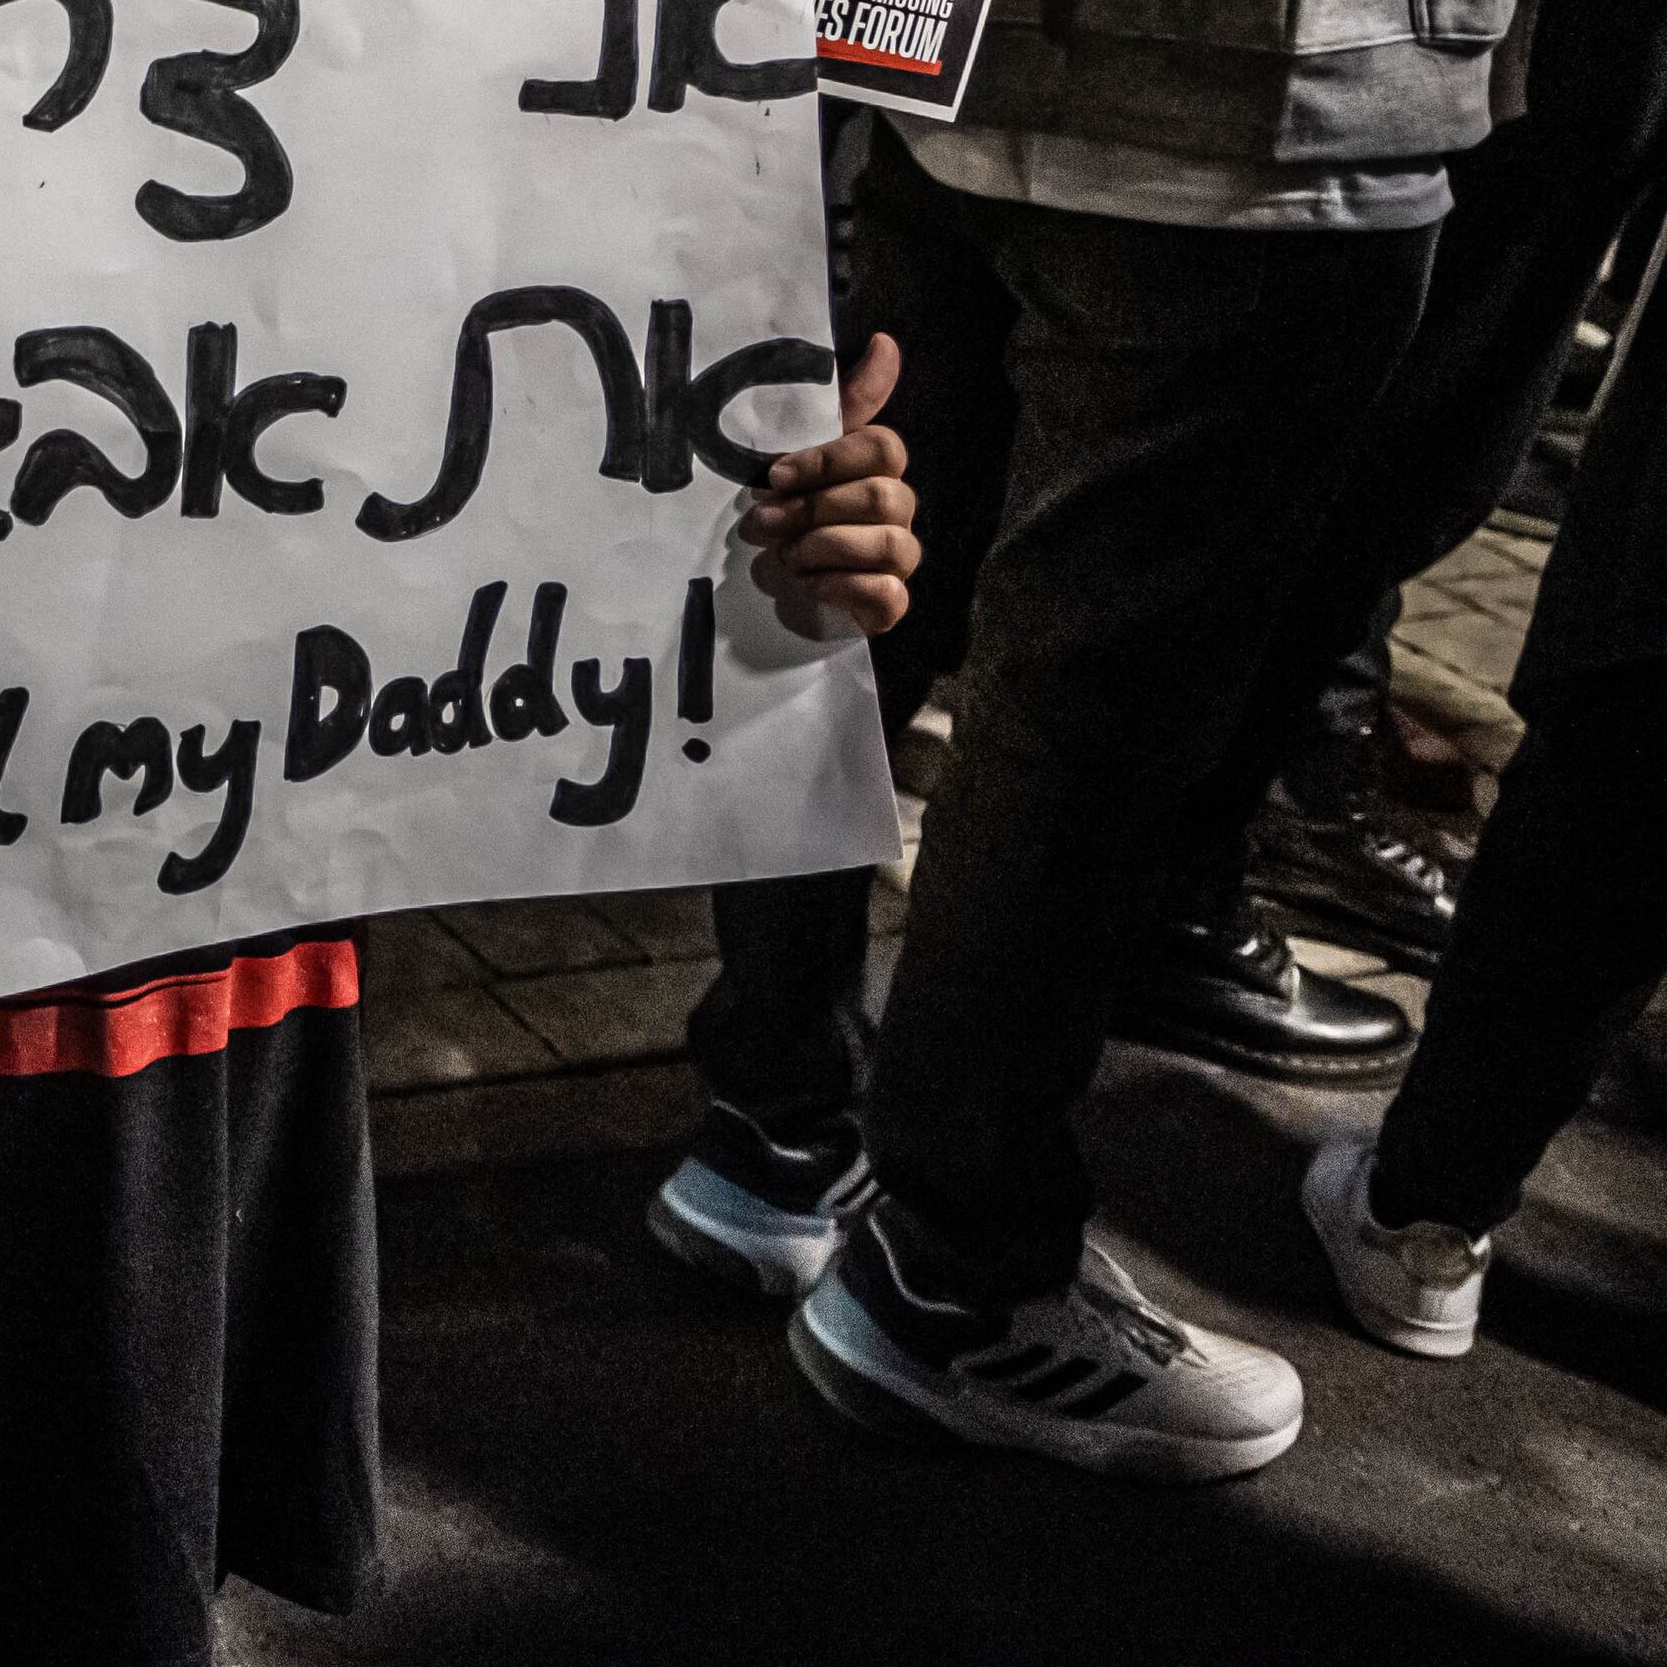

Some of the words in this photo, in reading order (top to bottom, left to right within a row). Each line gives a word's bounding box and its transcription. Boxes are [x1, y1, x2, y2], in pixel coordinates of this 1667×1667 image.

[847, 2, 948, 65] FORUM
[355, 284, 837, 542] את
[61, 714, 262, 895] my
[283, 576, 717, 827] Daddy!
